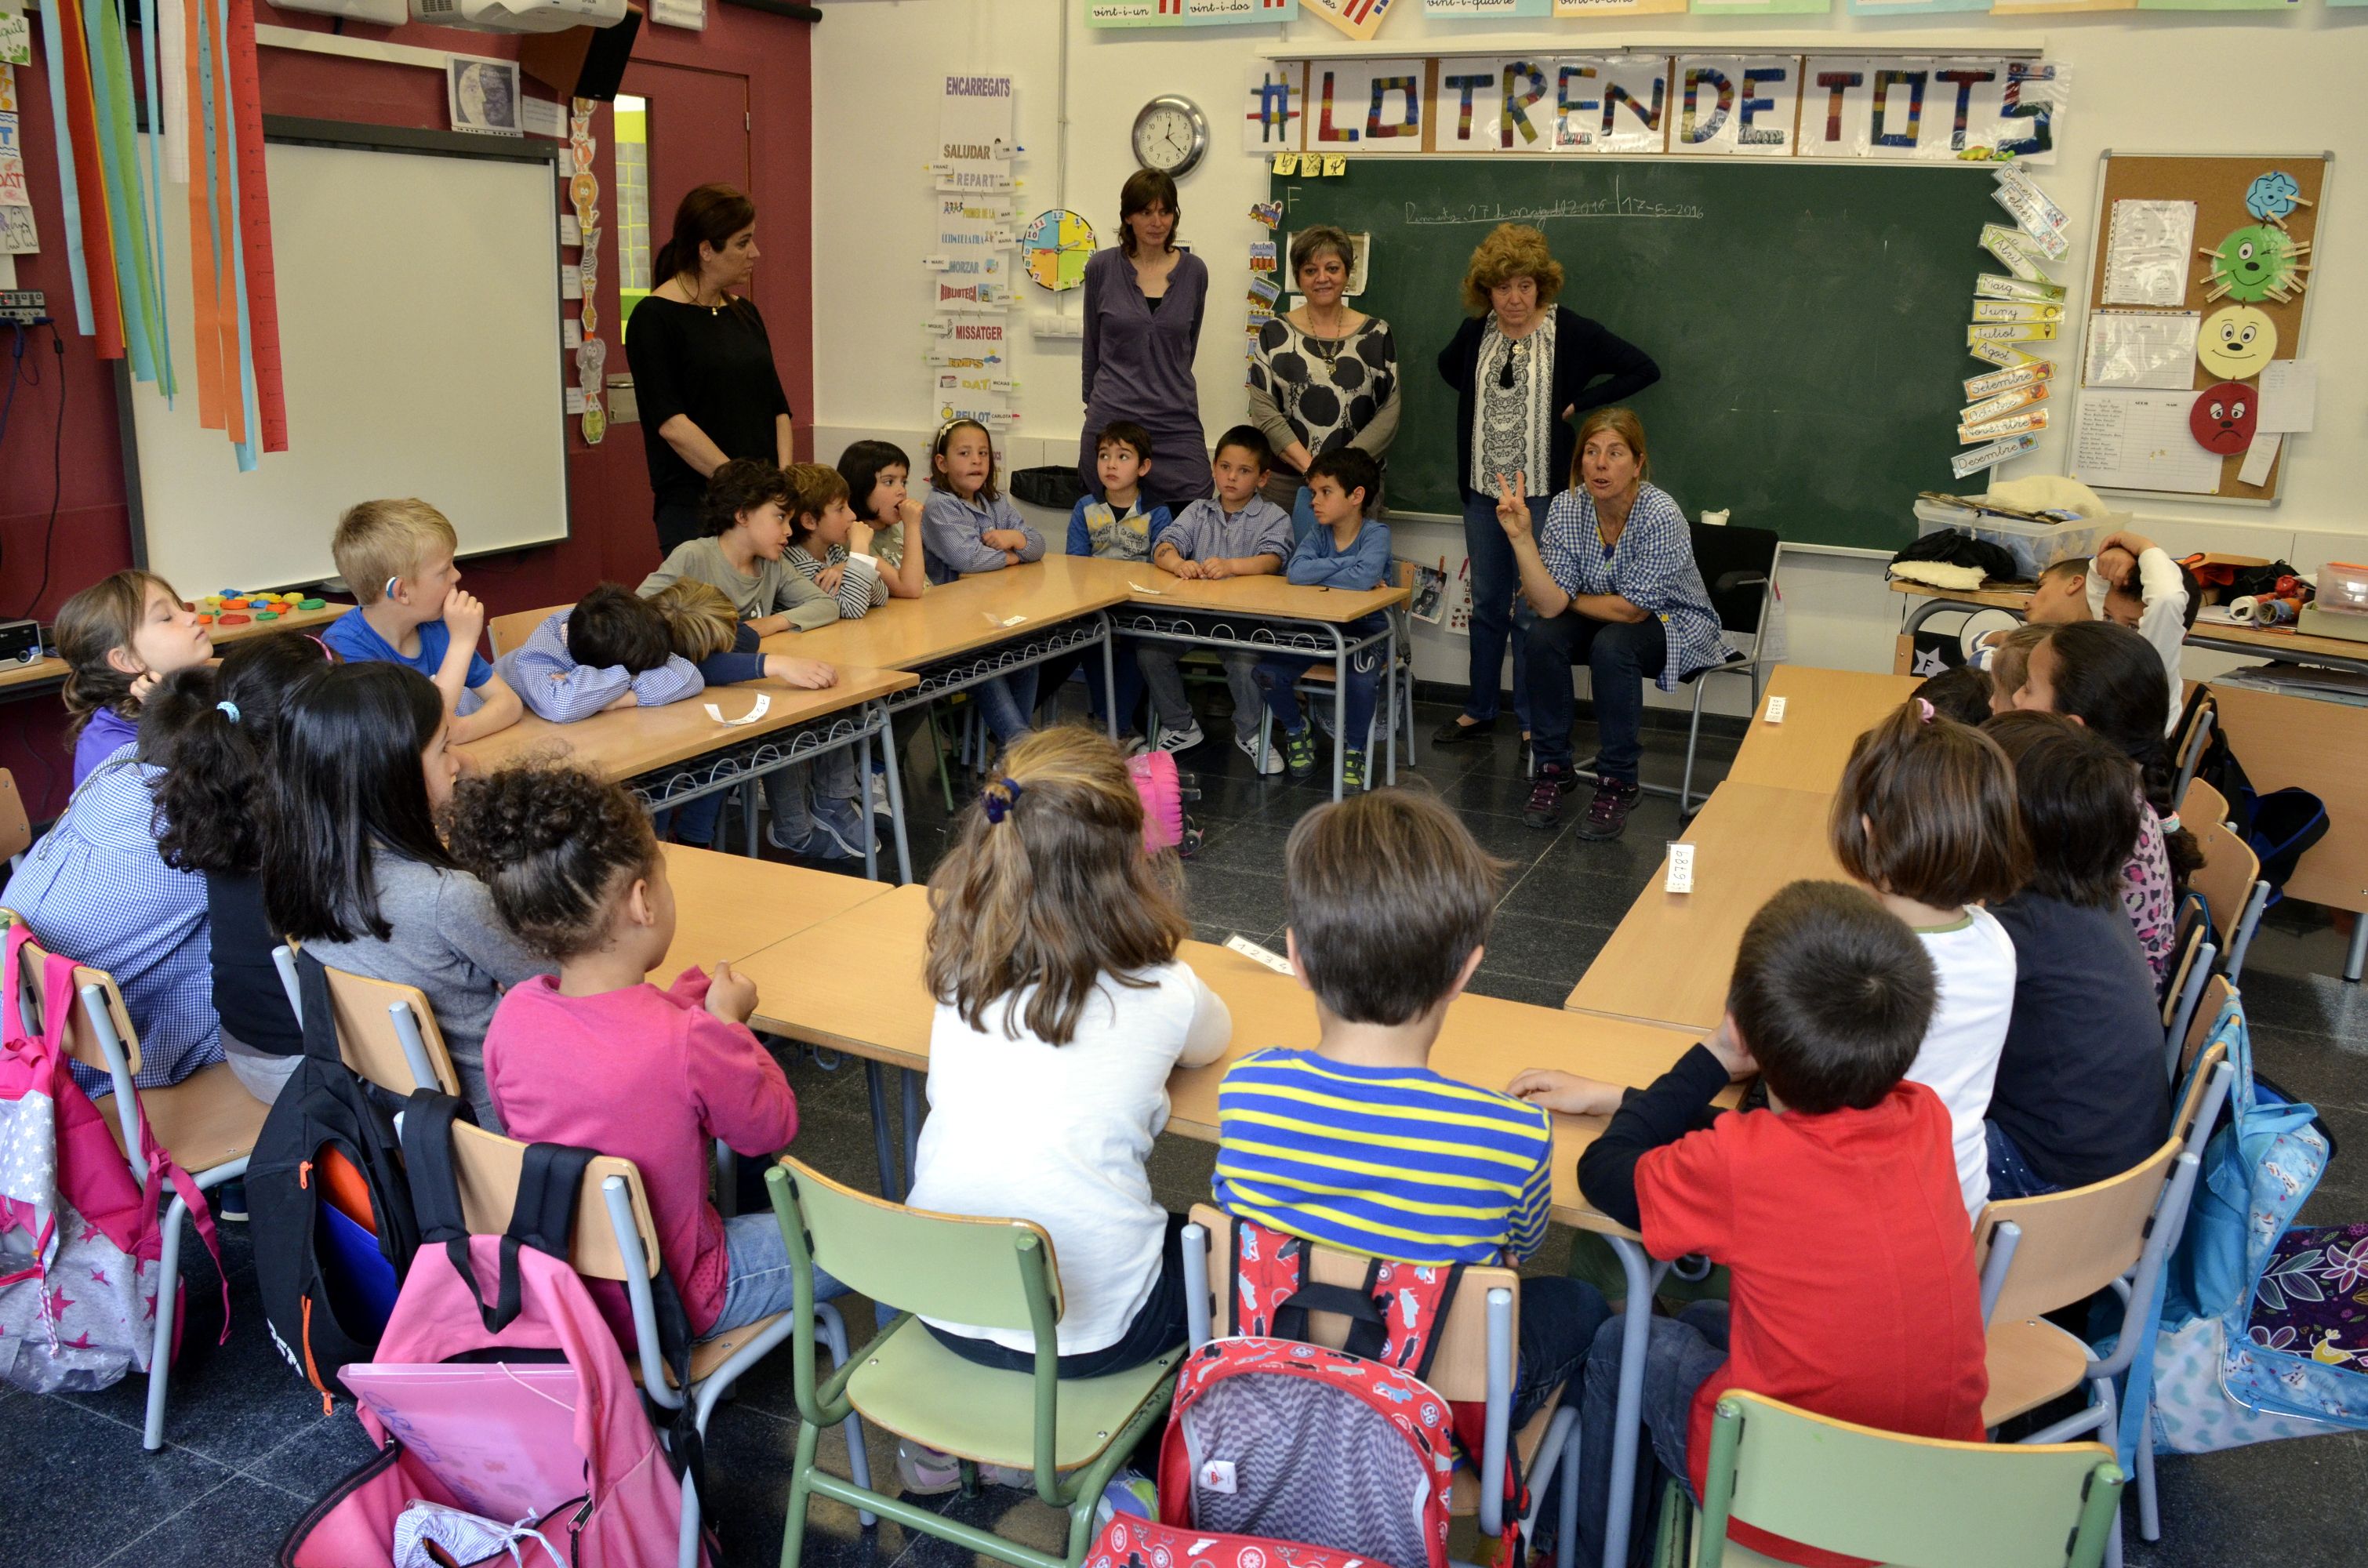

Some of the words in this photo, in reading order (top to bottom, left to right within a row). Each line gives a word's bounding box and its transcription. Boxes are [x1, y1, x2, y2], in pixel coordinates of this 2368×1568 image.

[1093, 8, 1149, 16] vint-i-un
[1189, 2, 1251, 13] vint-i-dos
[946, 76, 1010, 97] ENCARREGATS
[943, 143, 990, 159] SALUDAR
[957, 172, 1001, 187] REPART
[2003, 187, 2032, 222] Febrer
[1033, 220, 1044, 229] 11
[1994, 239, 2022, 267] Abril
[946, 260, 979, 274] MORZAR
[940, 283, 977, 303] BIBLIOTECA
[1982, 278, 2014, 296] Maig
[1979, 304, 2018, 321] Juny
[956, 325, 1002, 340] MISSATGER
[1974, 327, 2015, 339] Juliol
[1978, 343, 2010, 361] Agost
[948, 357, 984, 369] EMPS
[961, 379, 990, 390] DAT
[1971, 372, 2032, 394] Setembre
[1957, 444, 2019, 470] Desembre
[1923, 659, 1934, 672] F
[1673, 850, 1689, 880] 6789
